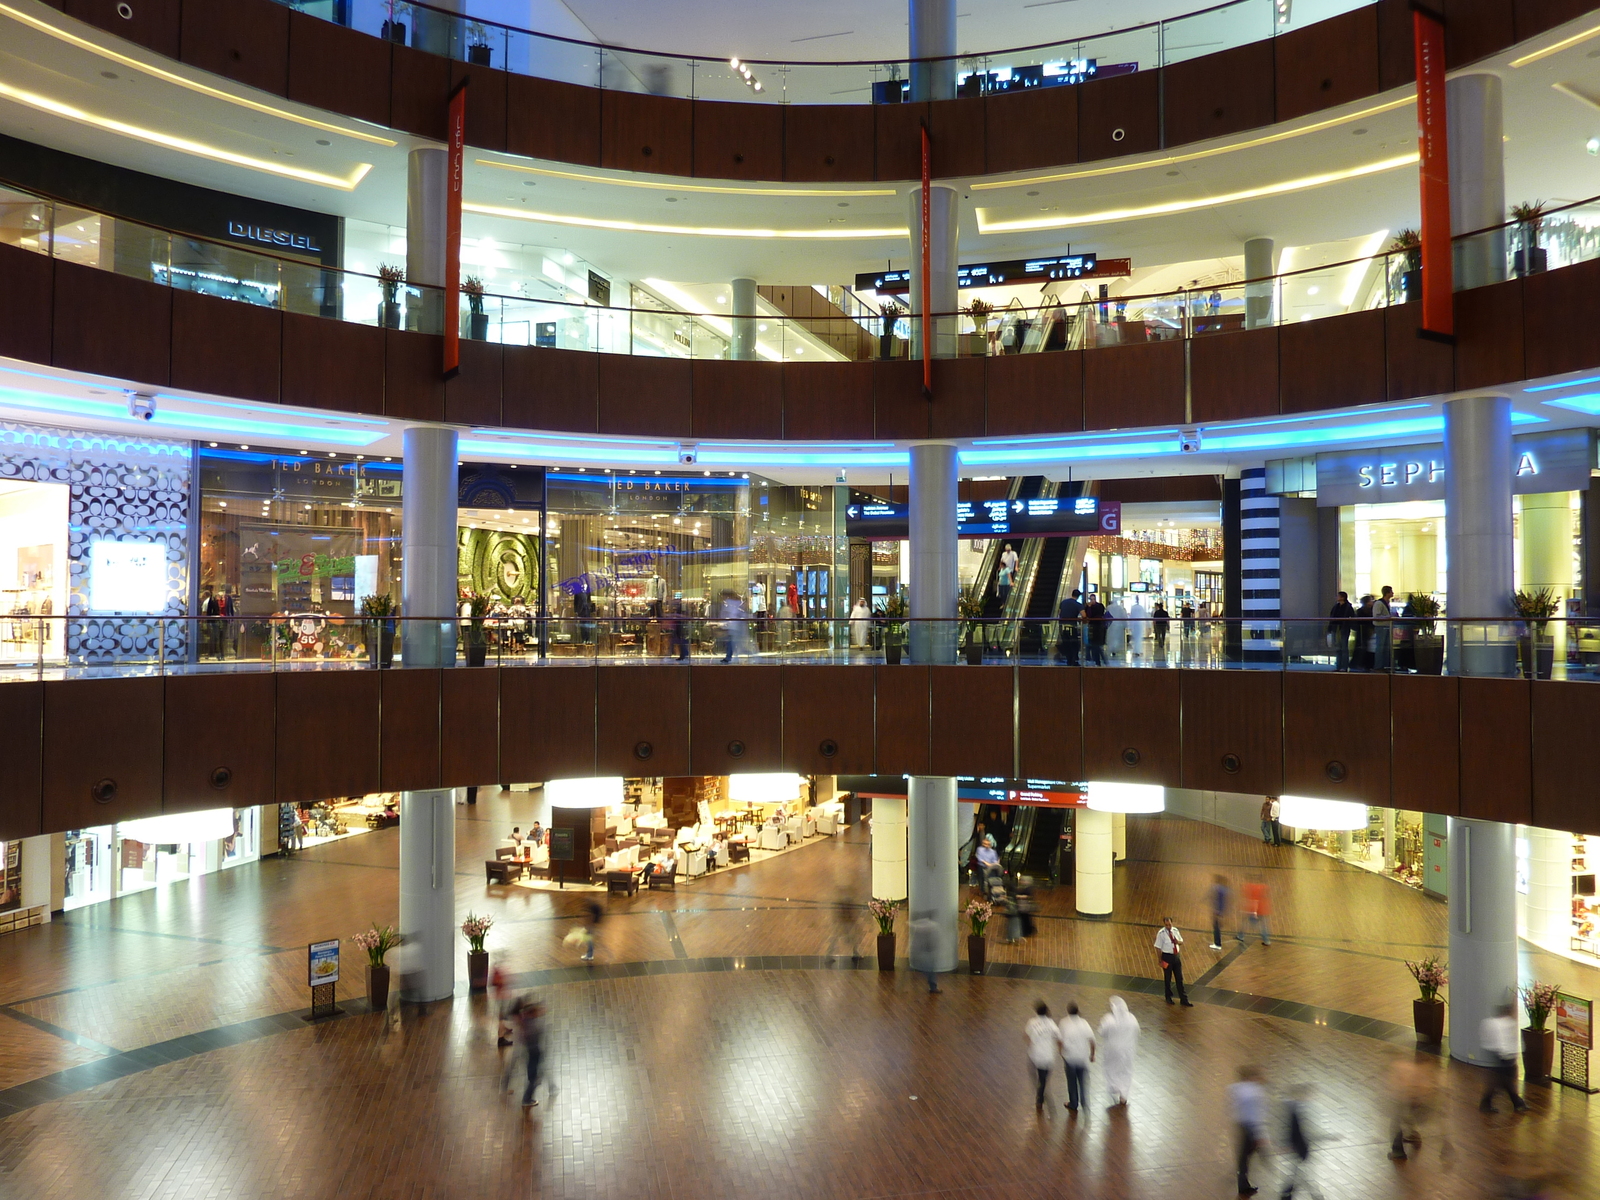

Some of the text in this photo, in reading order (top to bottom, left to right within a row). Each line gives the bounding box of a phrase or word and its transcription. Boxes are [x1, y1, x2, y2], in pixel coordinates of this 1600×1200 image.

[228, 220, 322, 252] DIESEL
[271, 459, 366, 477] TED BAKER
[1358, 452, 1538, 488] SEPHA
[296, 478, 341, 486] LONDON
[607, 480, 690, 491] TED BAKER
[1101, 513, 1117, 530] G
[619, 544, 677, 566] SHOULD
